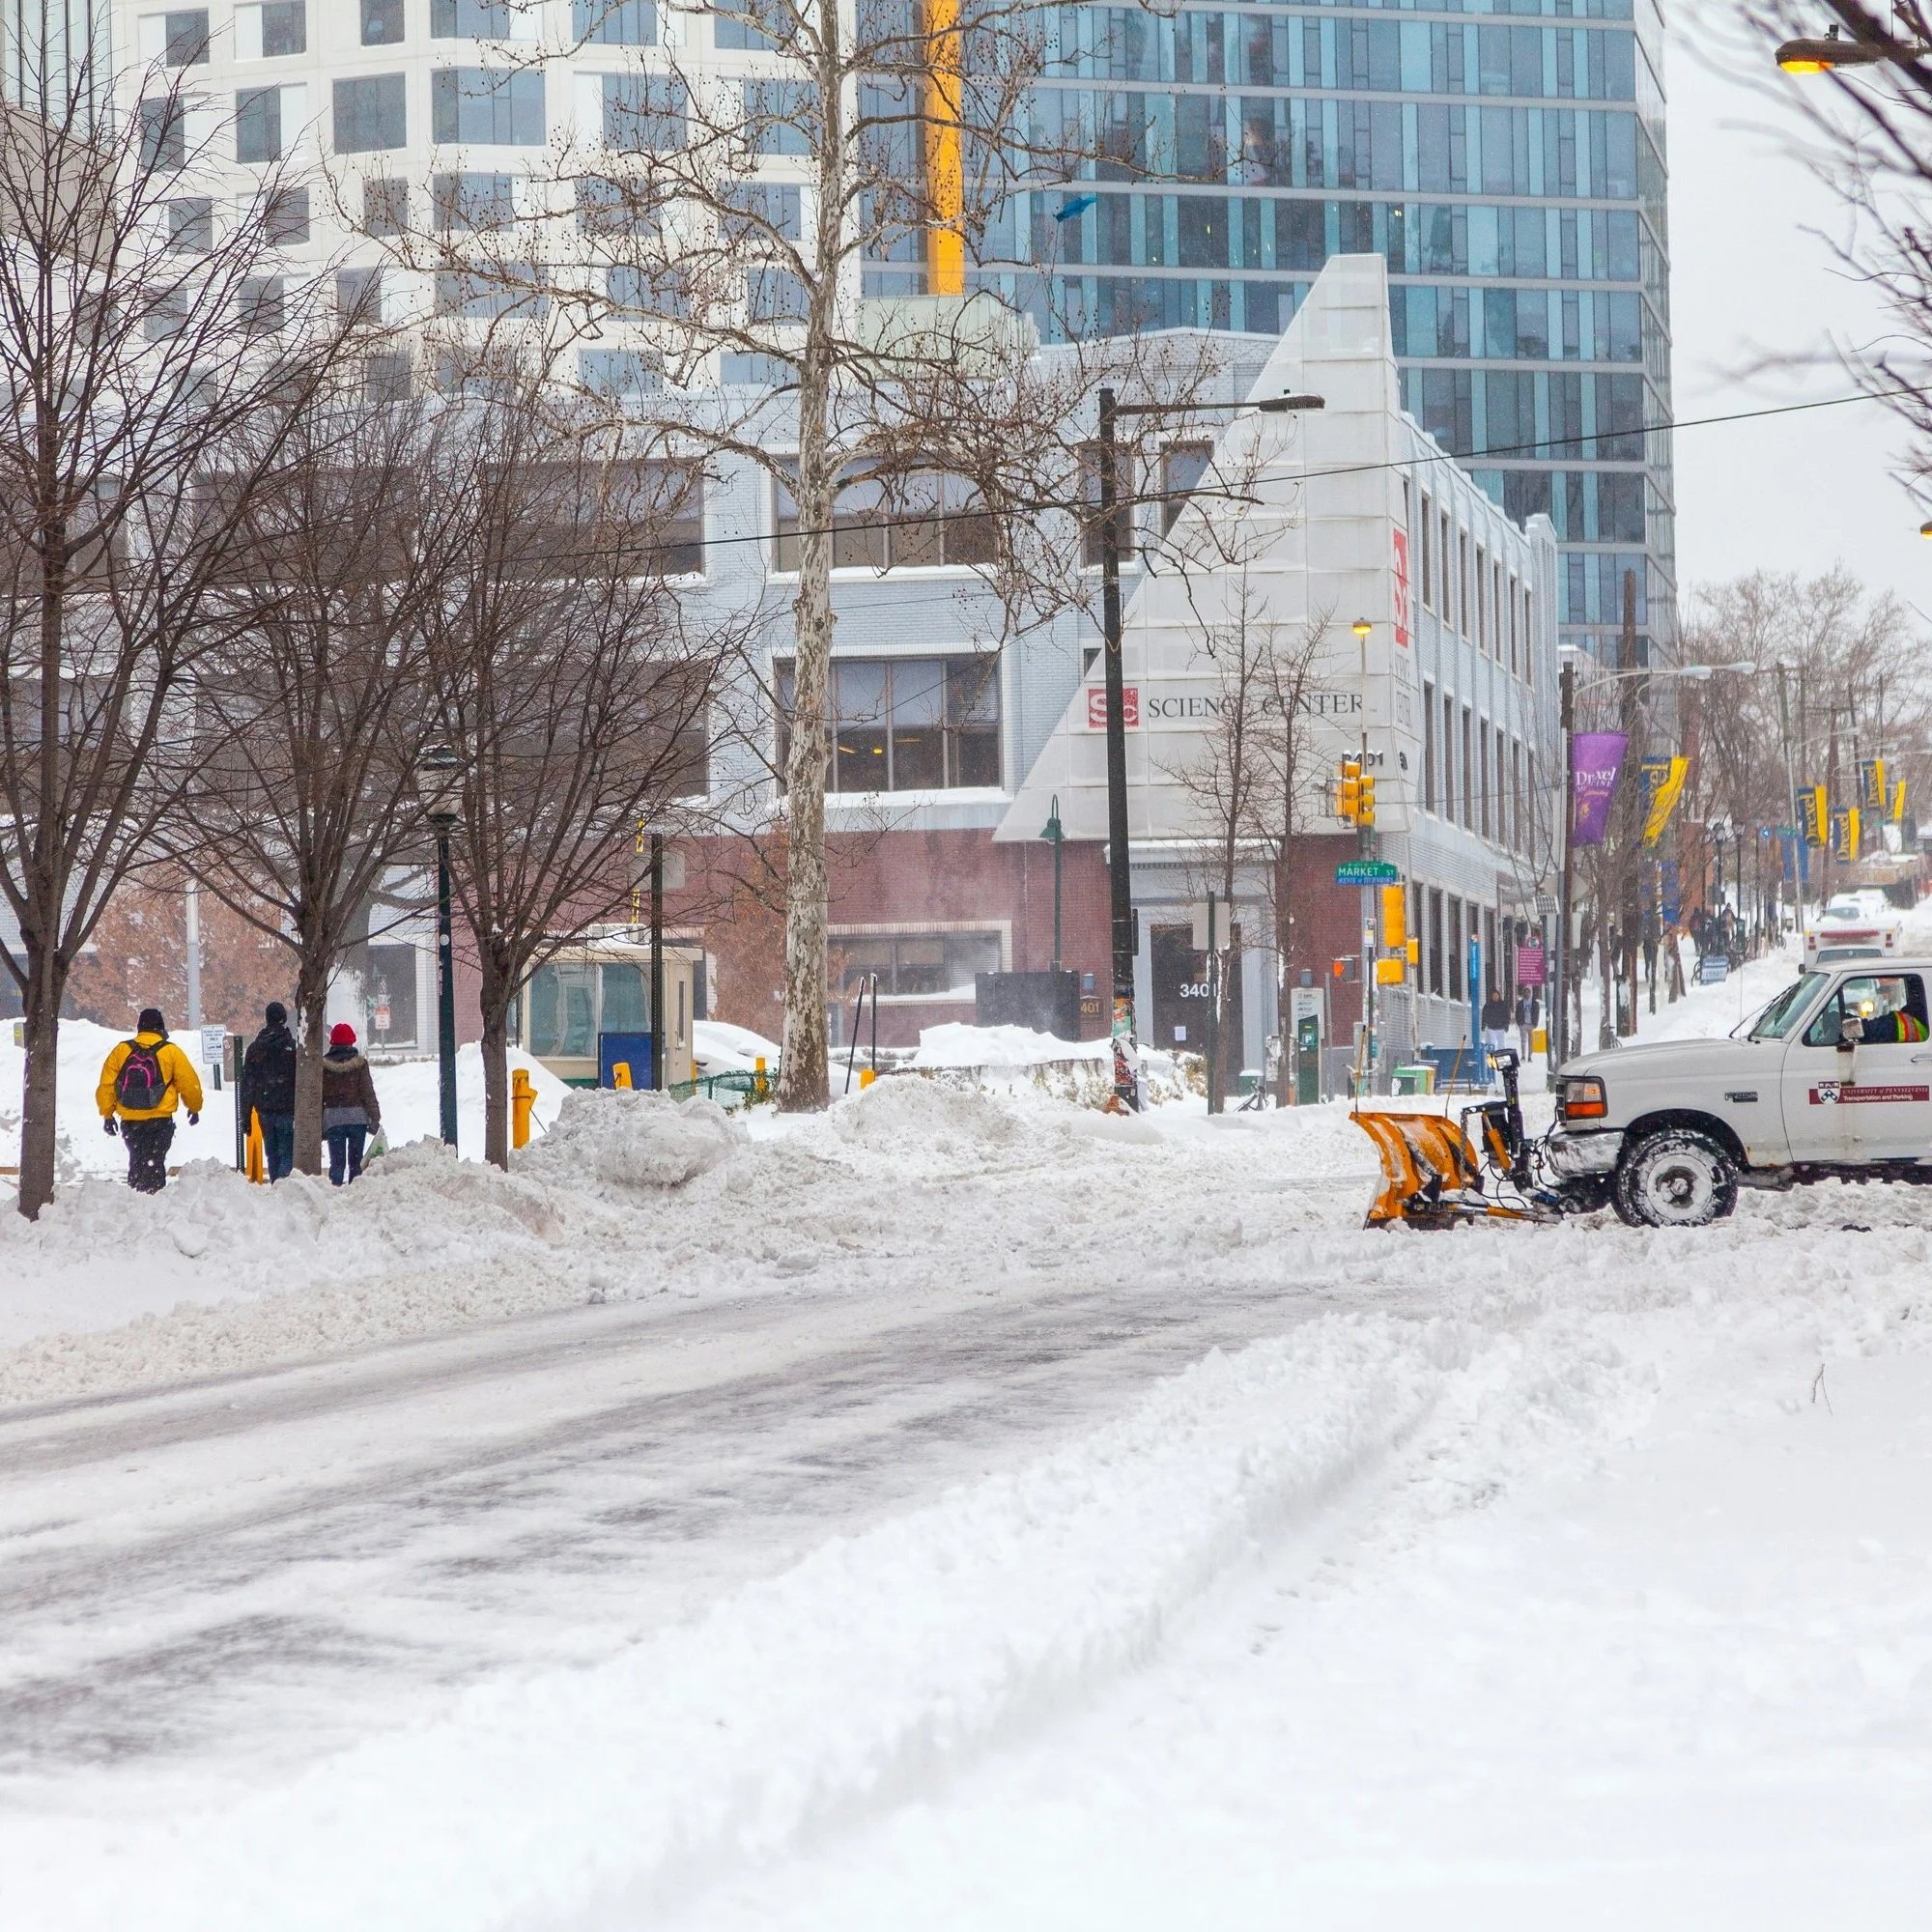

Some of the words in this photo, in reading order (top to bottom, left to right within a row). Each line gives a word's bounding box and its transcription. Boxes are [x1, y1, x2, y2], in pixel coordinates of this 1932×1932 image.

[1148, 696, 1252, 718] SCIENCE
[1262, 694, 1363, 715] CENTER
[1800, 793, 1820, 847] Drexel
[1338, 867, 1378, 876] MARKET
